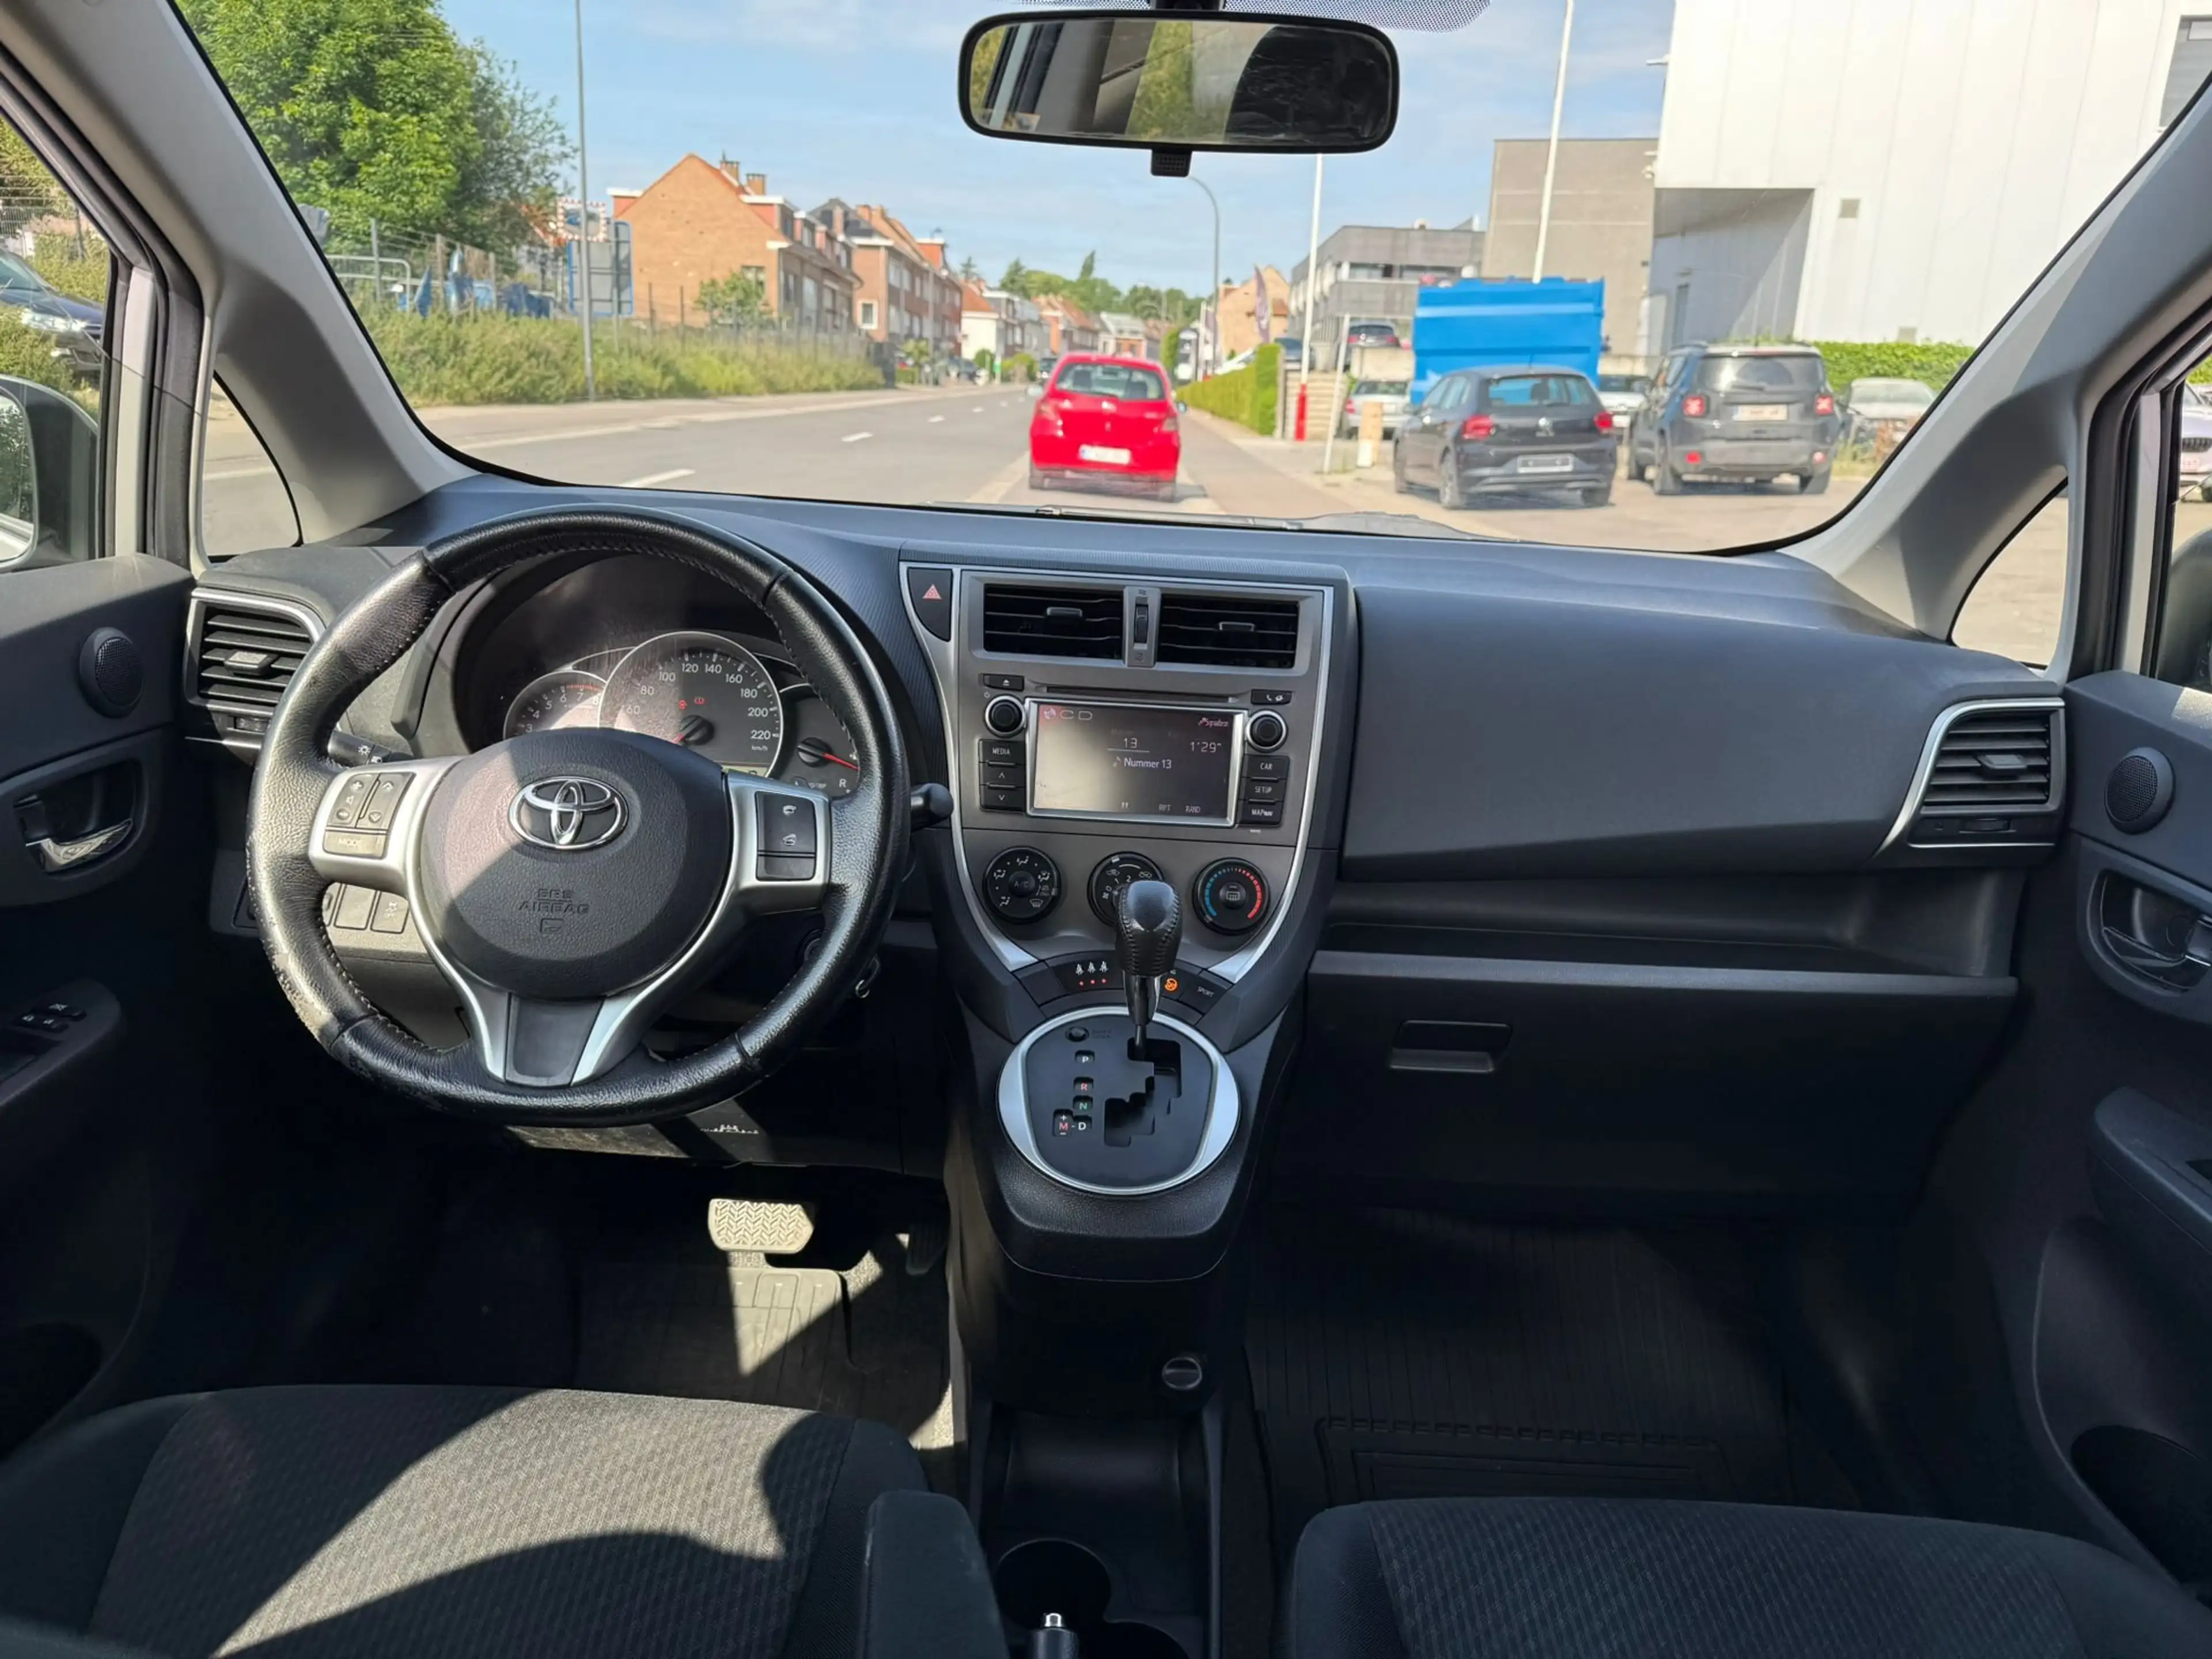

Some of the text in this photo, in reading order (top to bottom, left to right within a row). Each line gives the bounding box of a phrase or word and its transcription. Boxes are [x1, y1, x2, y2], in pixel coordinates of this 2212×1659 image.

[681, 663, 698, 673] 120
[704, 664, 722, 674] 140
[659, 672, 676, 681] 100
[725, 673, 743, 683] 160
[640, 685, 654, 696] 80
[741, 688, 757, 698] 180
[560, 693, 566, 702] 6
[577, 693, 584, 701] 7
[546, 700, 552, 709] 5
[626, 704, 640, 715] 60
[533, 710, 540, 719] 4
[748, 707, 768, 717] 200
[1060, 710, 1093, 720] CD
[525, 724, 532, 733] 3
[751, 730, 771, 740] 220
[1123, 737, 1138, 749] 13
[992, 747, 1010, 755] MEDIA
[1123, 757, 1172, 769] Nummer 13
[519, 900, 590, 914] AIRBAG
[1081, 1083, 1088, 1091] R
[1078, 1122, 1086, 1130] D
